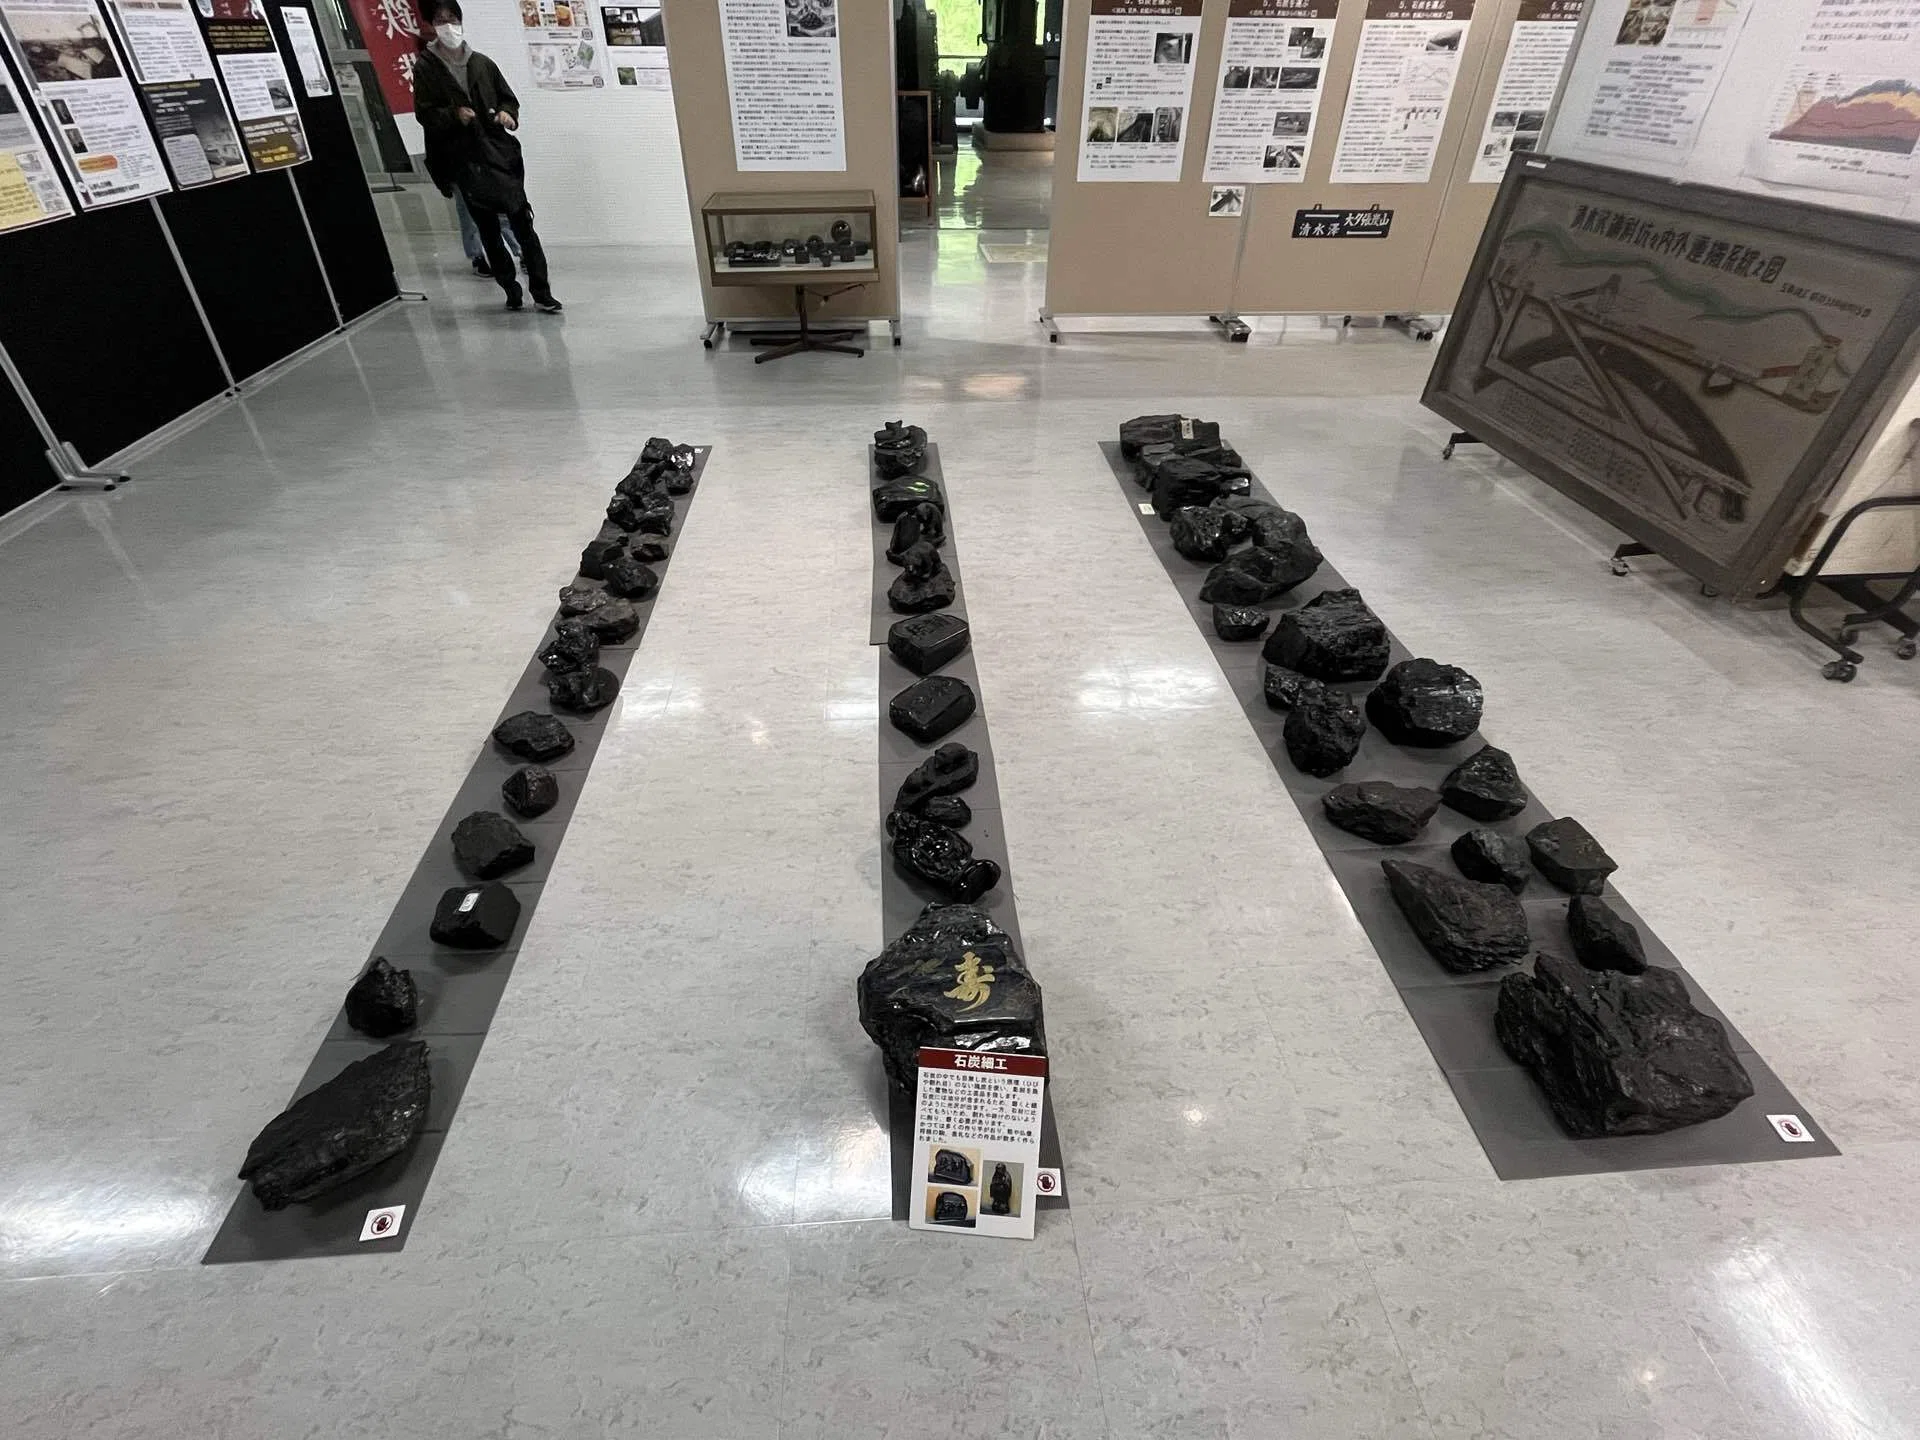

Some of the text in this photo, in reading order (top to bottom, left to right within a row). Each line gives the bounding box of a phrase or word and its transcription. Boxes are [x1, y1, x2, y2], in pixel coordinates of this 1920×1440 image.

[1343, 212, 1390, 227] 大夕張炭山
[943, 951, 996, 1013] 寿
[954, 1053, 1008, 1071] 石炭細工
